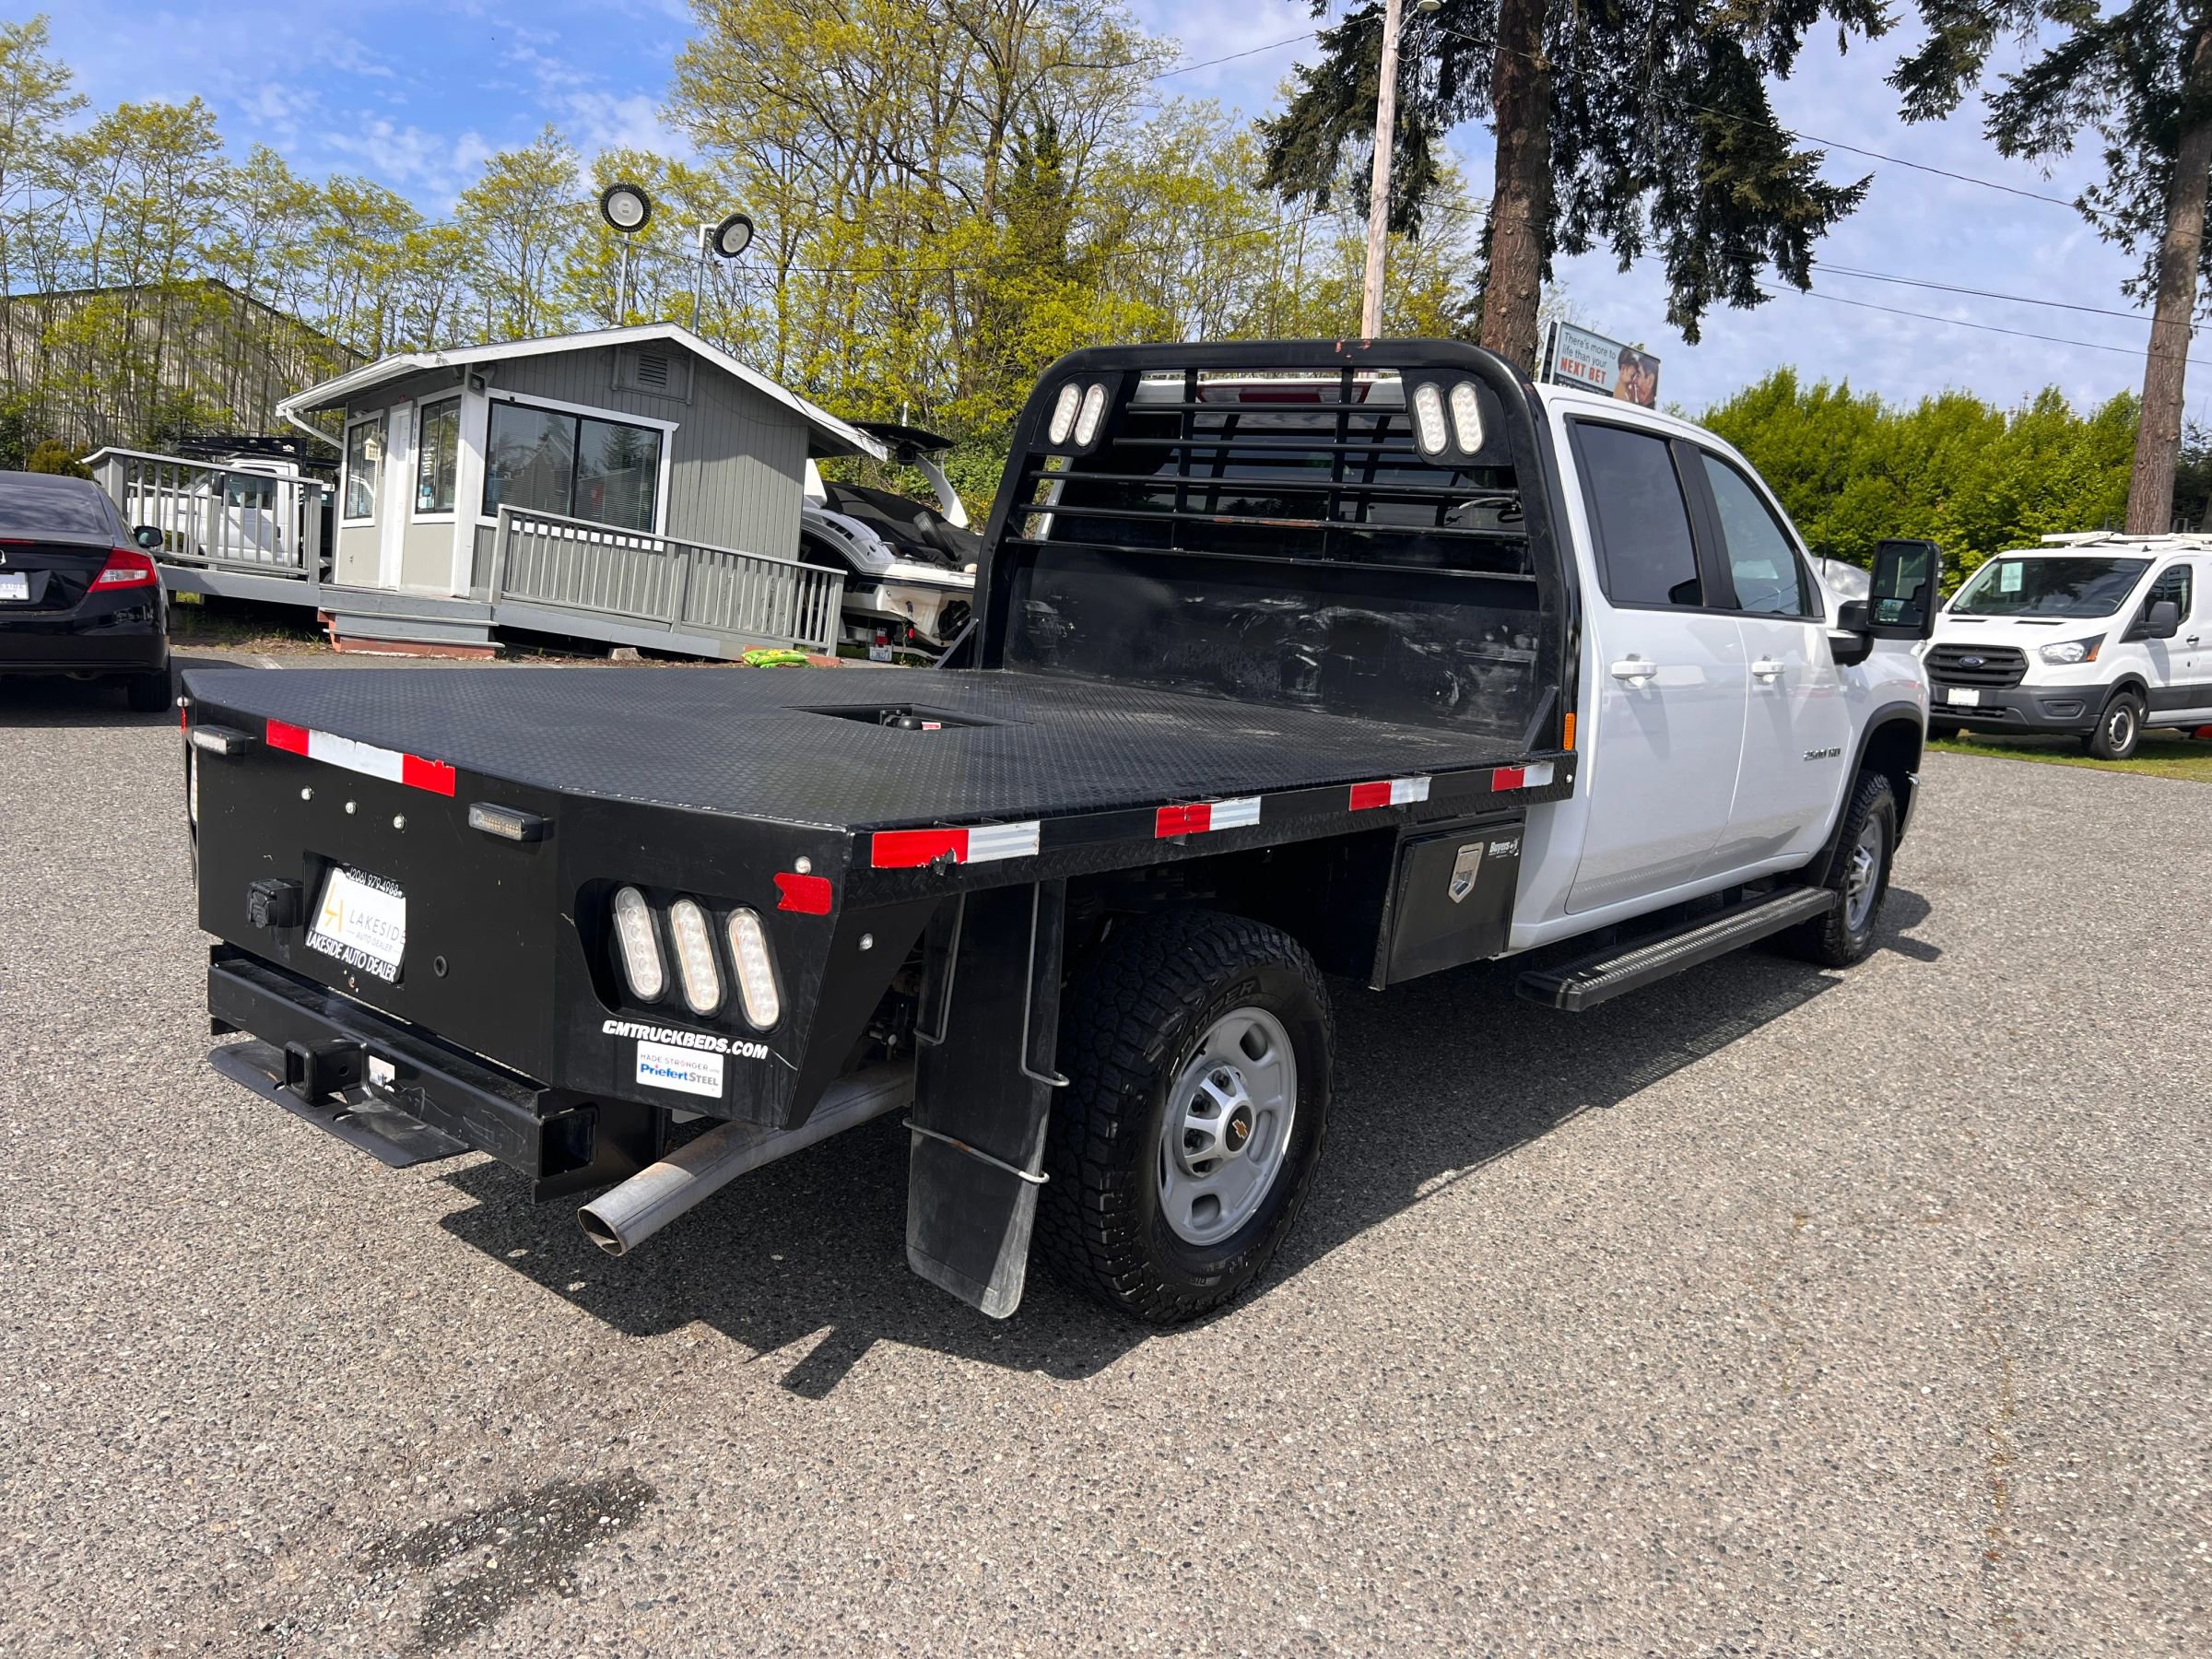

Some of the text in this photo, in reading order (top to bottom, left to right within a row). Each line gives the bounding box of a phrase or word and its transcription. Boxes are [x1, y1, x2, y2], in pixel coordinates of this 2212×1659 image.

[1562, 344, 1607, 368] life than your
[1564, 332, 1617, 360] There's more to
[1560, 357, 1606, 384] NEXT BET
[306, 930, 397, 983] LAKESIDE AUTO DEALER
[602, 1019, 769, 1060] CMTRUCKBEDS.COM
[641, 1053, 662, 1063] MADE
[665, 1057, 709, 1071] STRONGER
